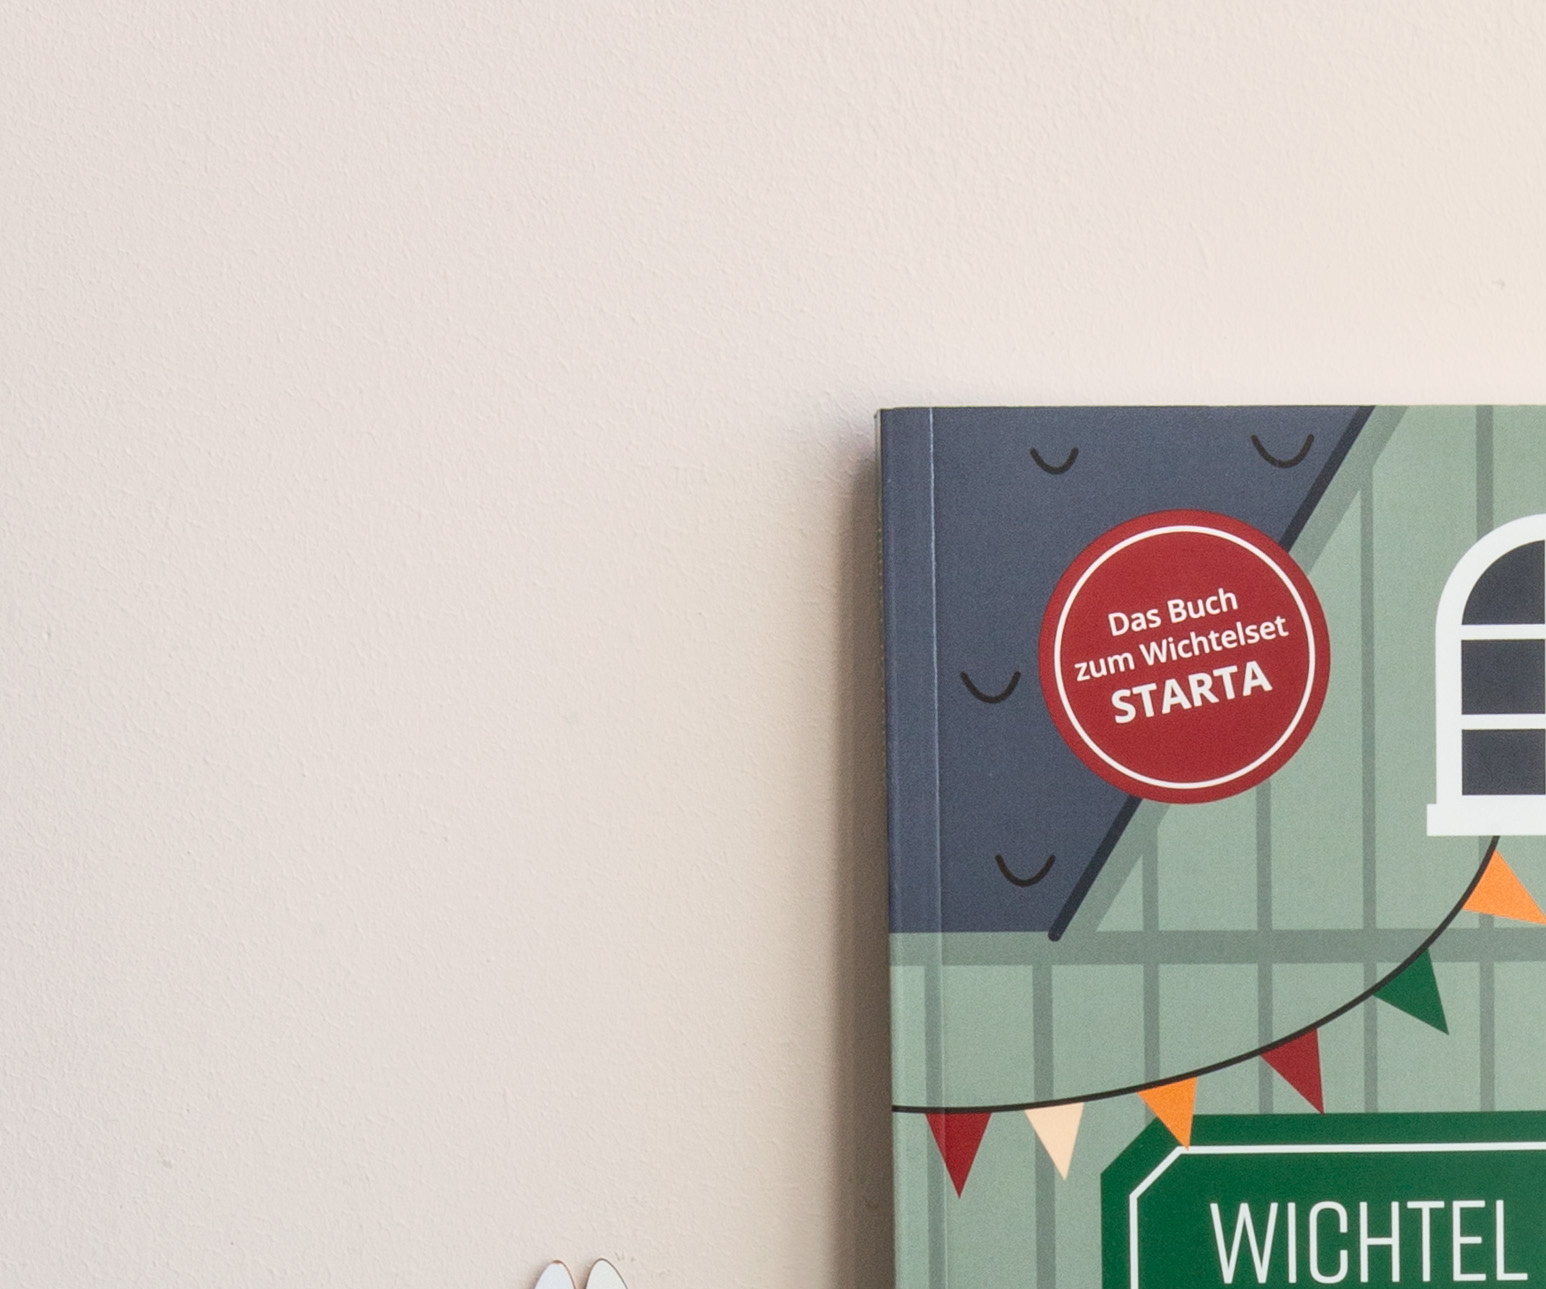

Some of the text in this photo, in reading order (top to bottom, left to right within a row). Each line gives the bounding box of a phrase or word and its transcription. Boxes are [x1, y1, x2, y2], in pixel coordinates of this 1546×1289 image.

[1108, 588, 1238, 637] Das Buch
[1074, 615, 1289, 682] zum Wichtelset
[1111, 660, 1272, 724] STARTA
[1209, 1199, 1528, 1284] WICHTEL
